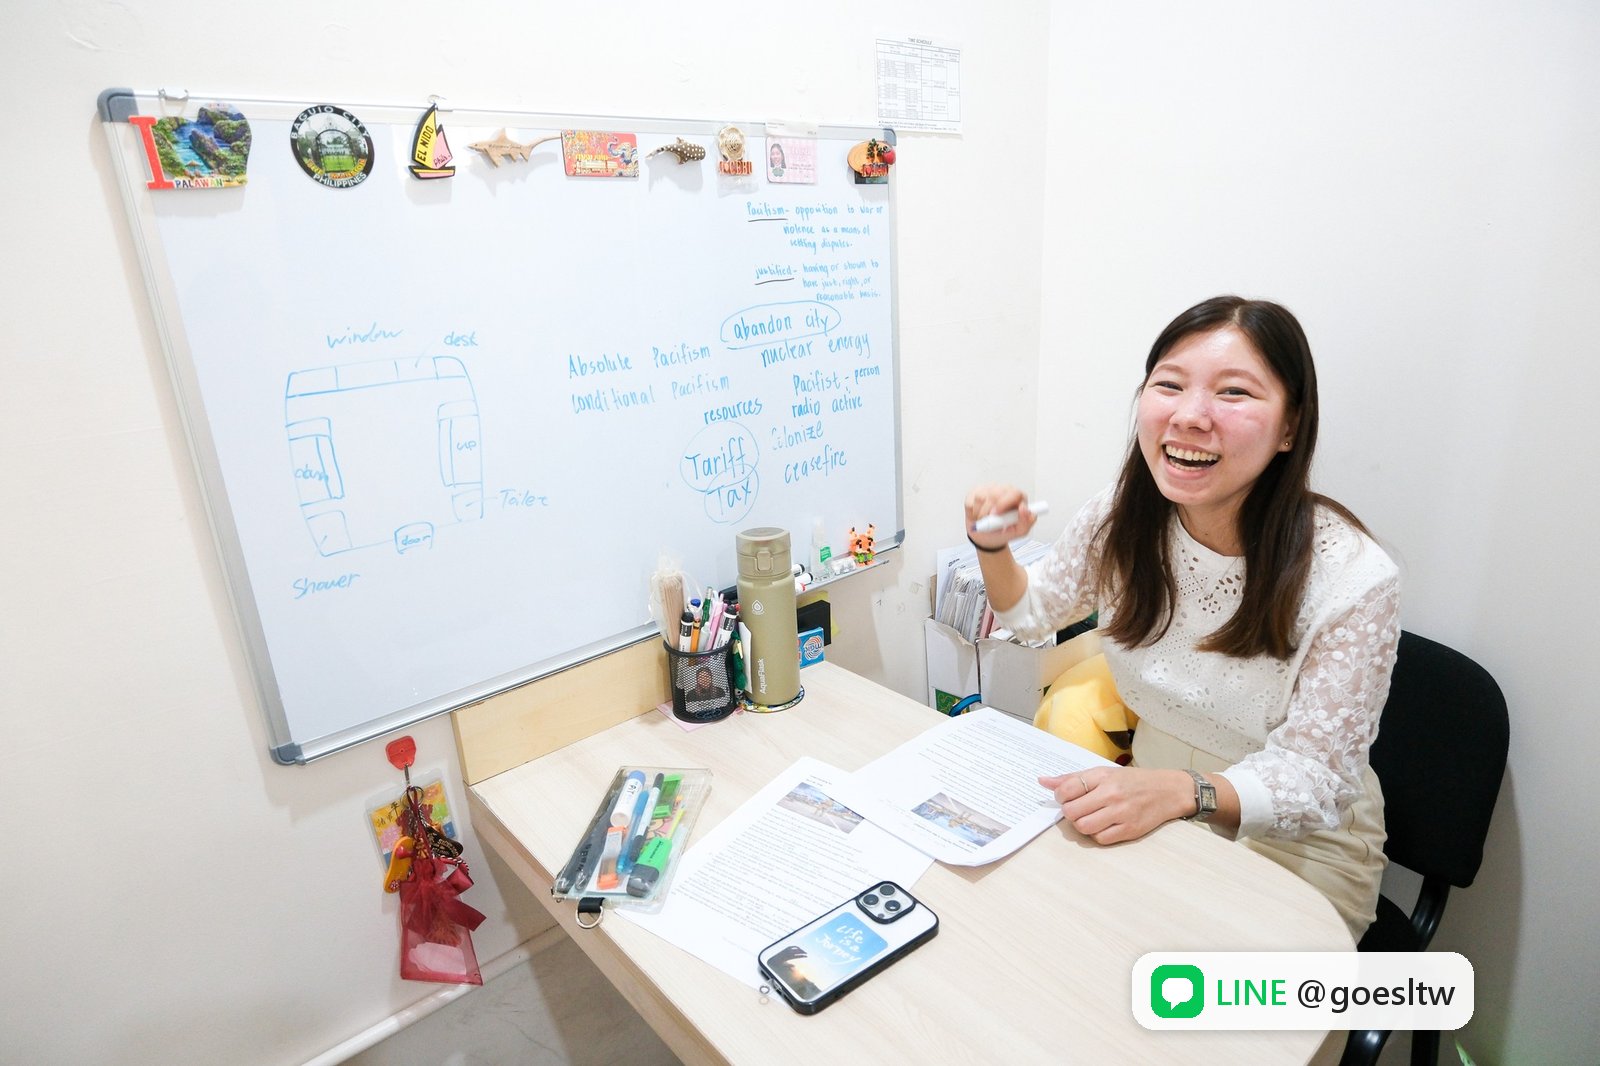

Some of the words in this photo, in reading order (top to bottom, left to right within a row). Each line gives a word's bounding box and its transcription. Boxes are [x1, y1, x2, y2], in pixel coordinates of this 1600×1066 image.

[291, 106, 333, 139] BAGUIO
[343, 111, 371, 138] CITY
[420, 125, 434, 148] NIDO
[417, 150, 427, 162] EL
[175, 178, 223, 189] PALAWAN
[313, 172, 367, 188] PHILIPPINES
[795, 203, 838, 221] opposition
[847, 203, 855, 213] to
[876, 206, 883, 214] or
[783, 223, 815, 235] violence
[863, 224, 870, 236] of
[790, 238, 817, 255] settling
[803, 263, 828, 278] having
[844, 261, 867, 270] shown
[871, 259, 879, 268] to
[802, 278, 818, 288] have
[816, 291, 854, 302] reasonable
[327, 322, 403, 349] window
[734, 316, 793, 340] abandon
[806, 308, 829, 336] city
[444, 331, 479, 347] desk
[761, 339, 813, 368] nuclear
[828, 333, 871, 359] energy
[569, 352, 633, 379] Absolute
[652, 342, 711, 368] Pacifism
[672, 373, 730, 400] Pacifism
[793, 369, 841, 396] Pacifist
[854, 365, 880, 384] person
[704, 398, 763, 424] resources
[792, 396, 820, 418] radio
[832, 392, 863, 413] active
[685, 436, 746, 480] Tariff
[784, 444, 847, 484] ceasefire
[707, 477, 752, 516] Tax
[401, 533, 431, 546] door
[757, 658, 768, 694] AquaFlask
